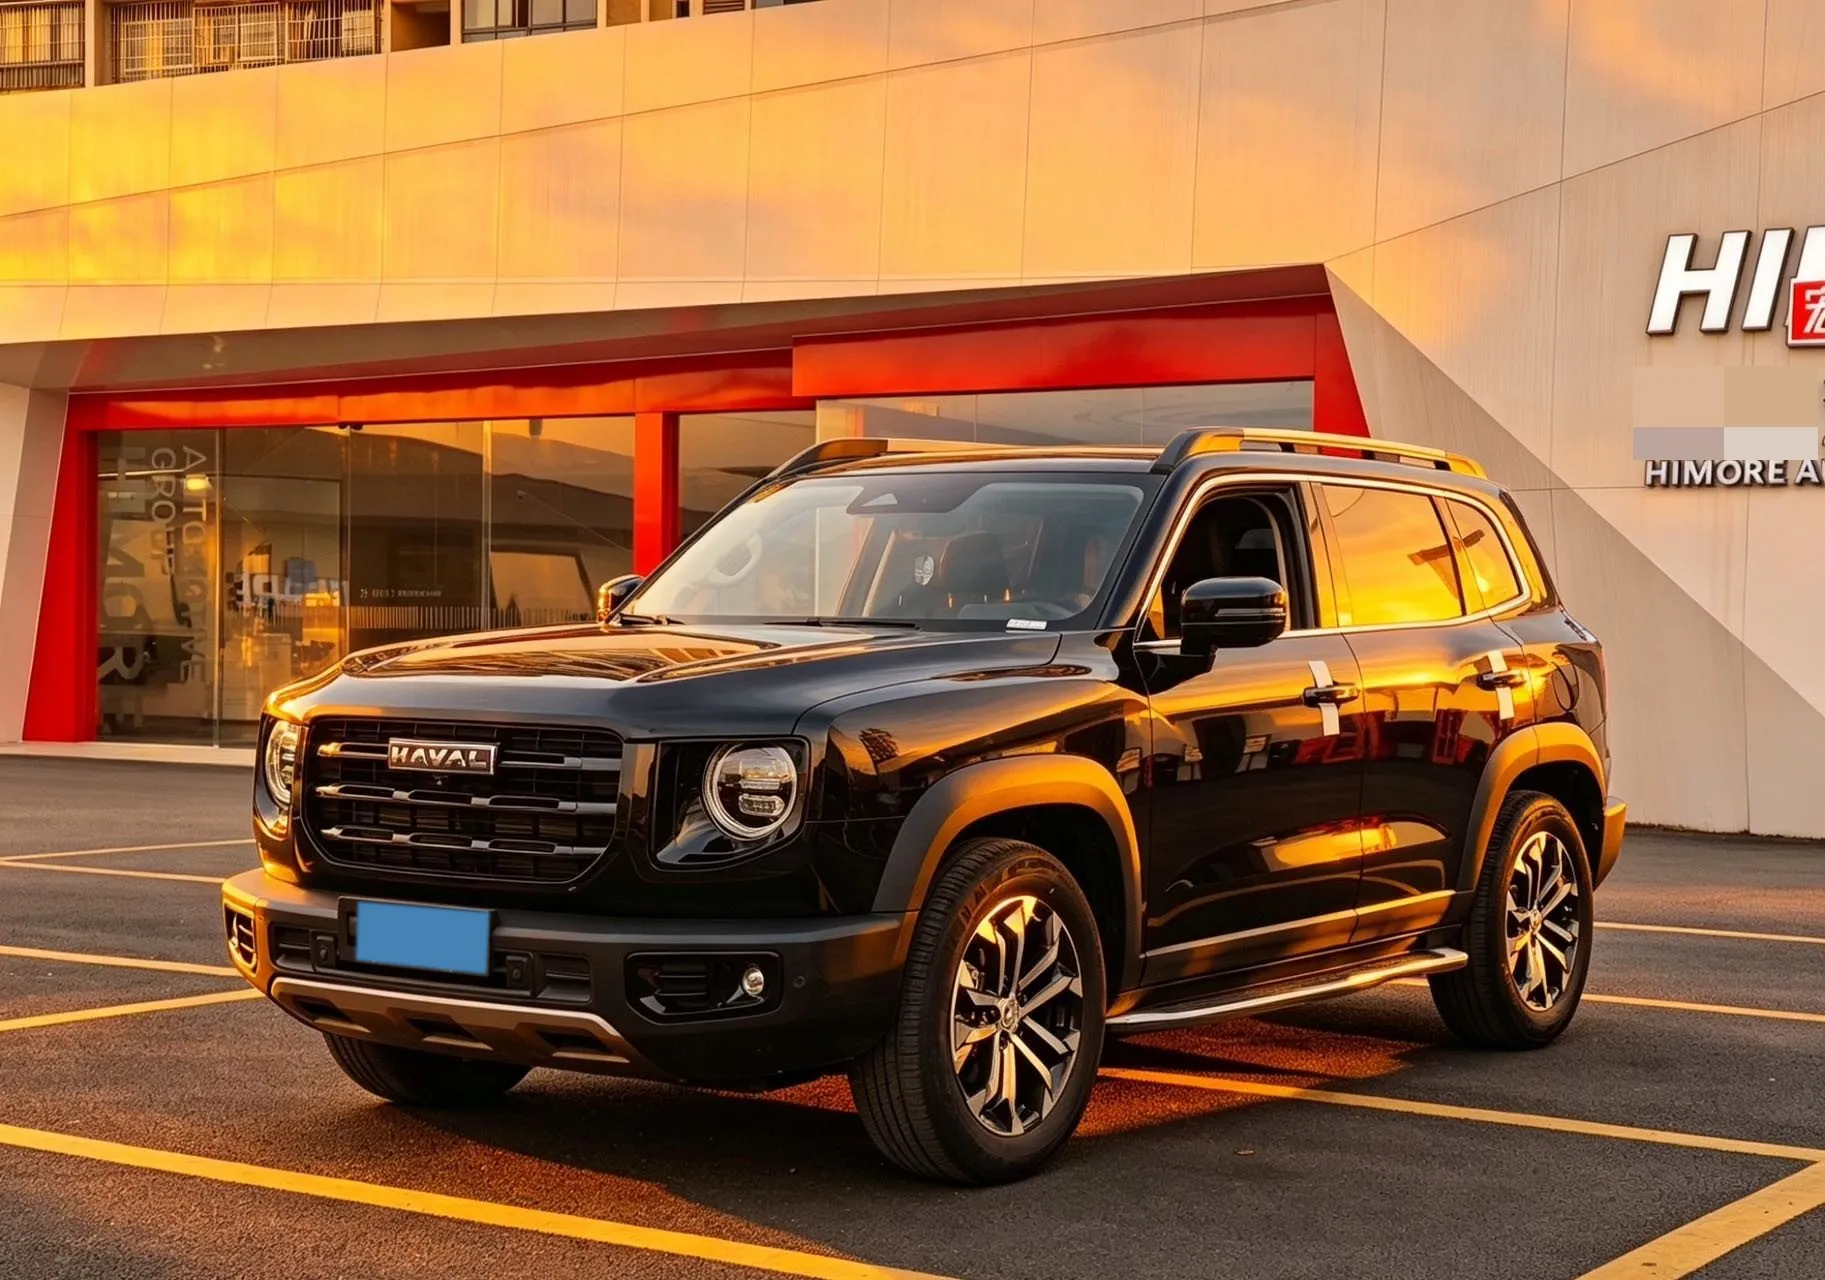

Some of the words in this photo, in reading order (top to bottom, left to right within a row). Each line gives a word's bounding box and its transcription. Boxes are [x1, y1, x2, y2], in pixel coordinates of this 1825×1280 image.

[1646, 225, 1825, 335] HI
[1645, 460, 1787, 487] HIMORE
[1795, 460, 1825, 487] A
[181, 445, 208, 683] ATOOTIVE
[391, 746, 487, 768] HAVAL
